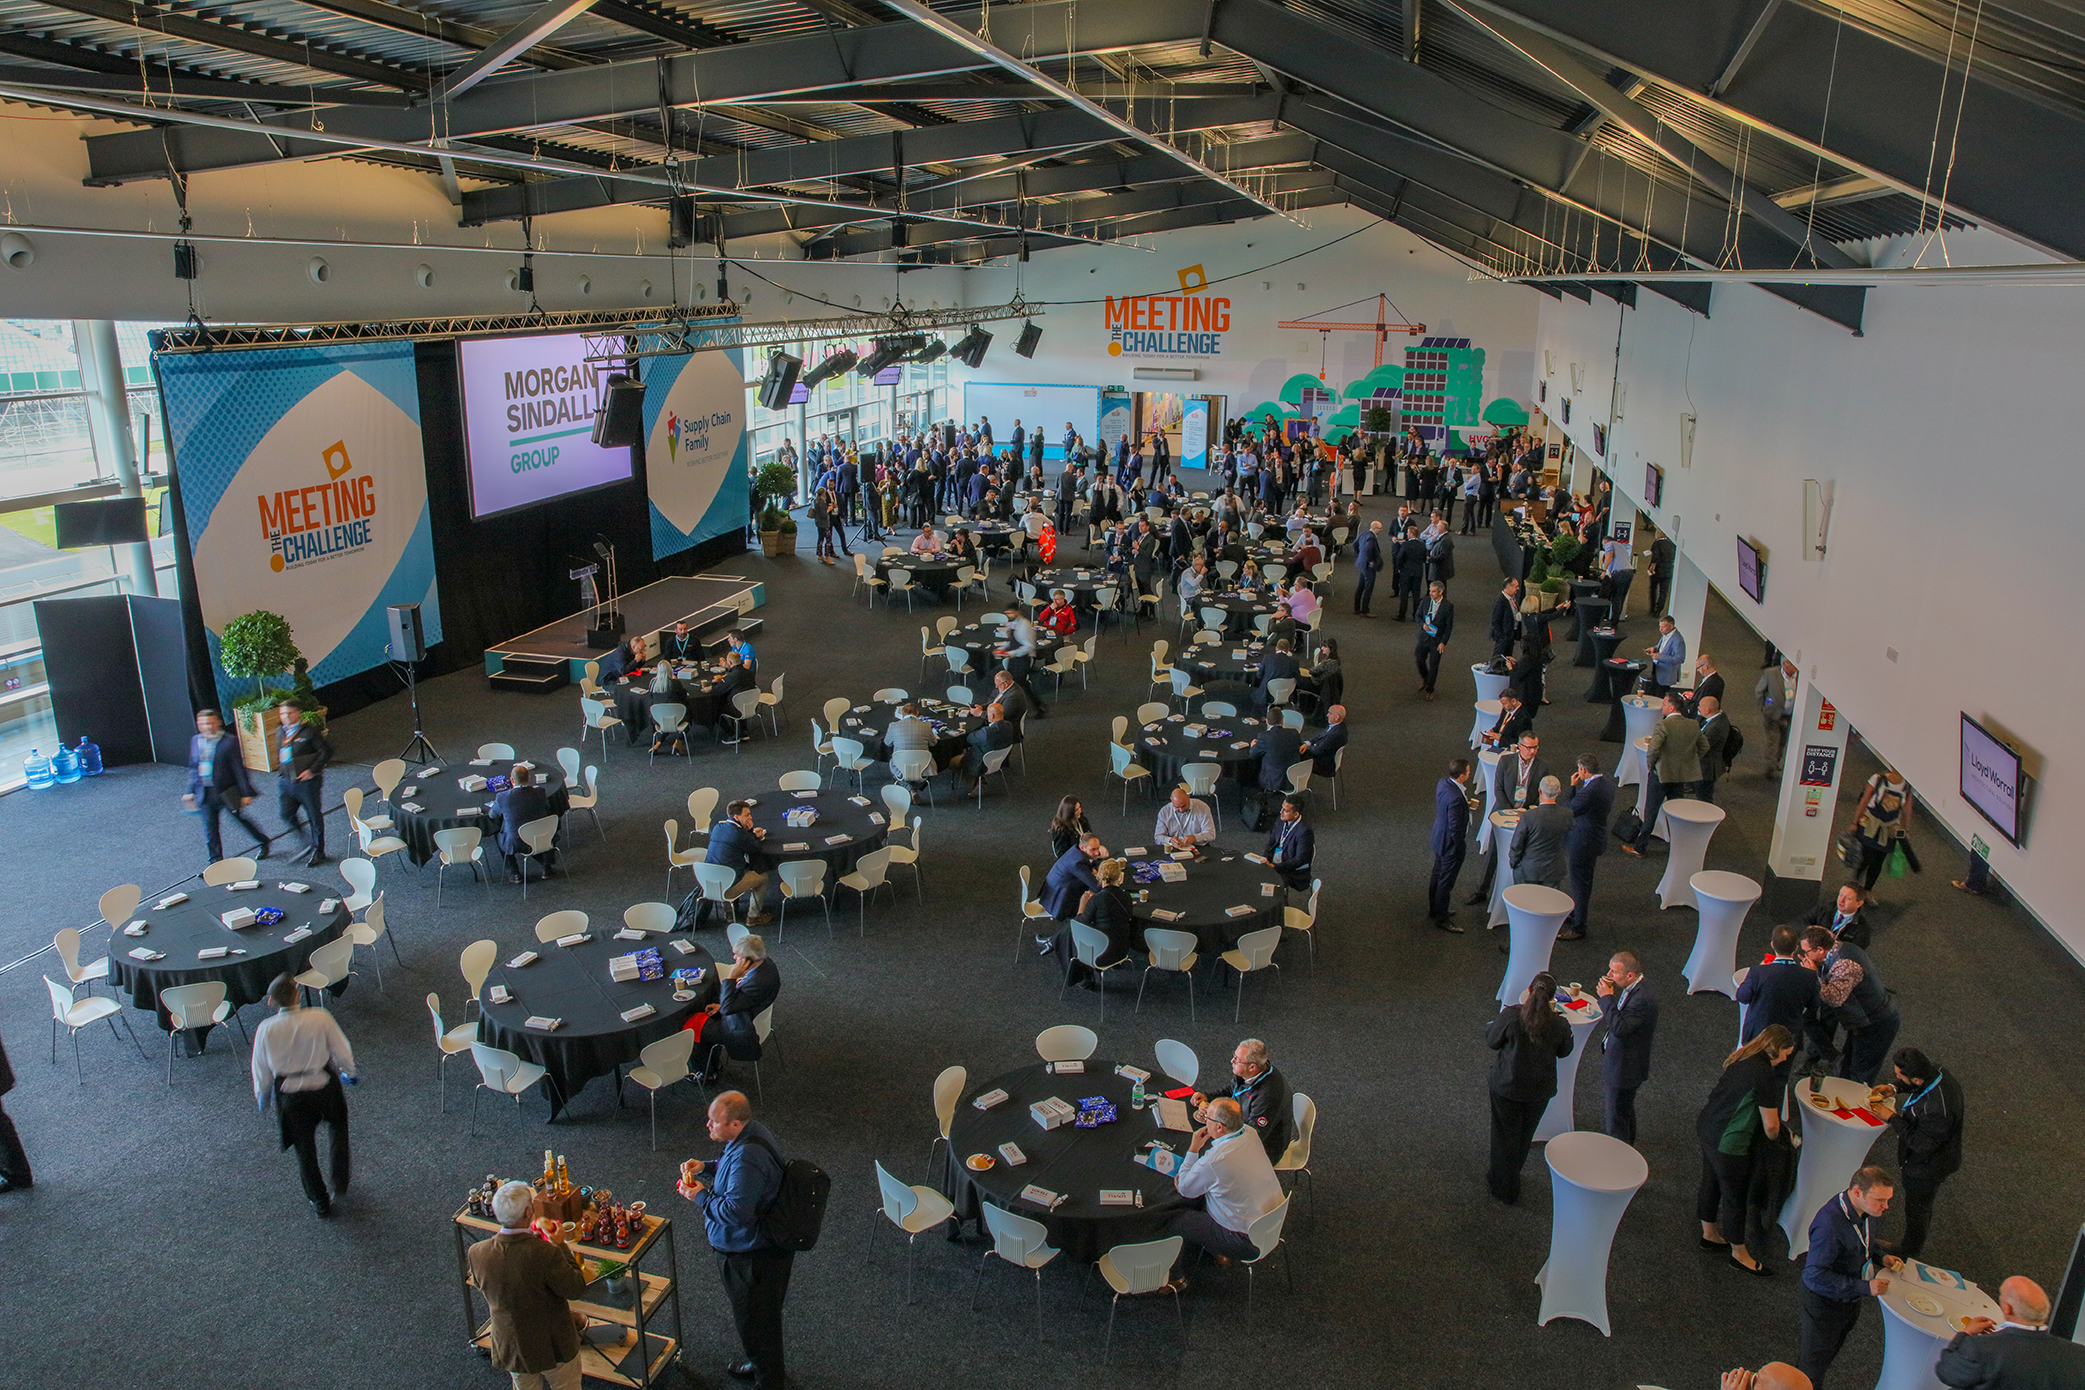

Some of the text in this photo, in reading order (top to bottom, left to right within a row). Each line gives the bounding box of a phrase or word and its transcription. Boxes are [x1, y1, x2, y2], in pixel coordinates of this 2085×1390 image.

[1105, 295, 1231, 332] MEETING
[1112, 324, 1122, 341] THE
[1122, 332, 1221, 354] CHALLENGE
[504, 363, 597, 401] MORGAN
[507, 394, 595, 433] SINDALL
[684, 411, 732, 435] Supply Chain
[685, 434, 710, 452] Family
[510, 446, 560, 474] GROUP
[258, 475, 376, 540] MEETING
[270, 530, 282, 553] THE
[282, 519, 373, 563] CHALLENGE
[1971, 753, 2014, 800] Lloyd Worrall
